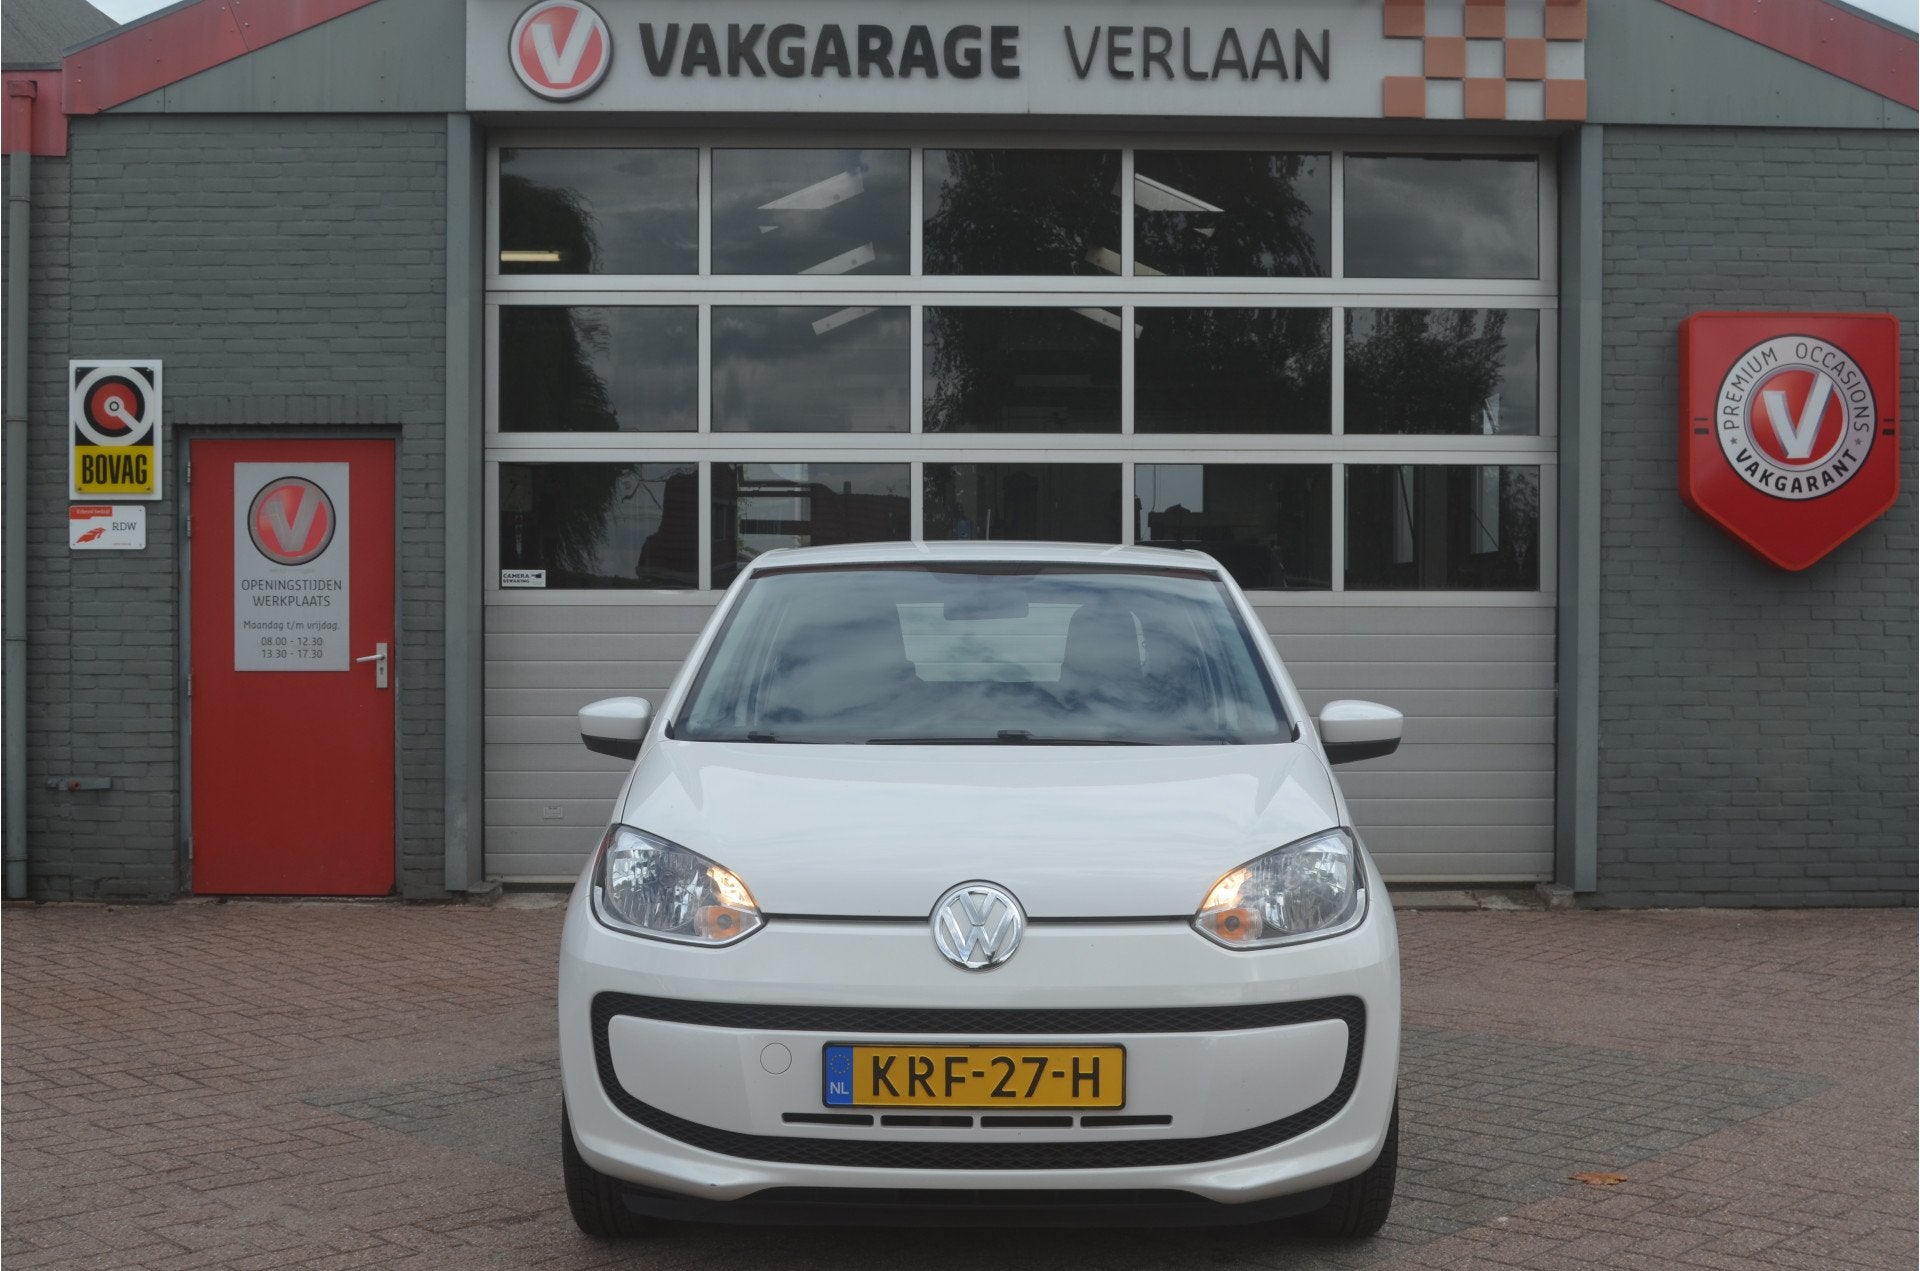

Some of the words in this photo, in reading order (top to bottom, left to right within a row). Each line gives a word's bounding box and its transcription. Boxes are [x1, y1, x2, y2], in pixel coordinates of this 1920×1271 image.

[639, 23, 1021, 79] VAKGARAGE
[1064, 25, 1330, 81] VERLAAN
[1723, 347, 1778, 431] PREMIUM
[1795, 342, 1870, 433] OCCASIONS
[82, 453, 148, 485] BOVAG
[1735, 448, 1858, 493] VAKGARANT
[112, 522, 137, 531] RDW
[241, 579, 342, 591] OPENINGSTIJDEN
[253, 595, 331, 607] WERKPLAATS
[243, 620, 284, 632] Maandag
[287, 620, 304, 631] t/m
[261, 636, 287, 646] 08.00
[297, 636, 323, 646] 12.30
[261, 649, 287, 659] 13.30
[297, 649, 323, 659] 17.30
[872, 1055, 1100, 1098] KRF-27-H
[829, 1082, 850, 1095] NL
